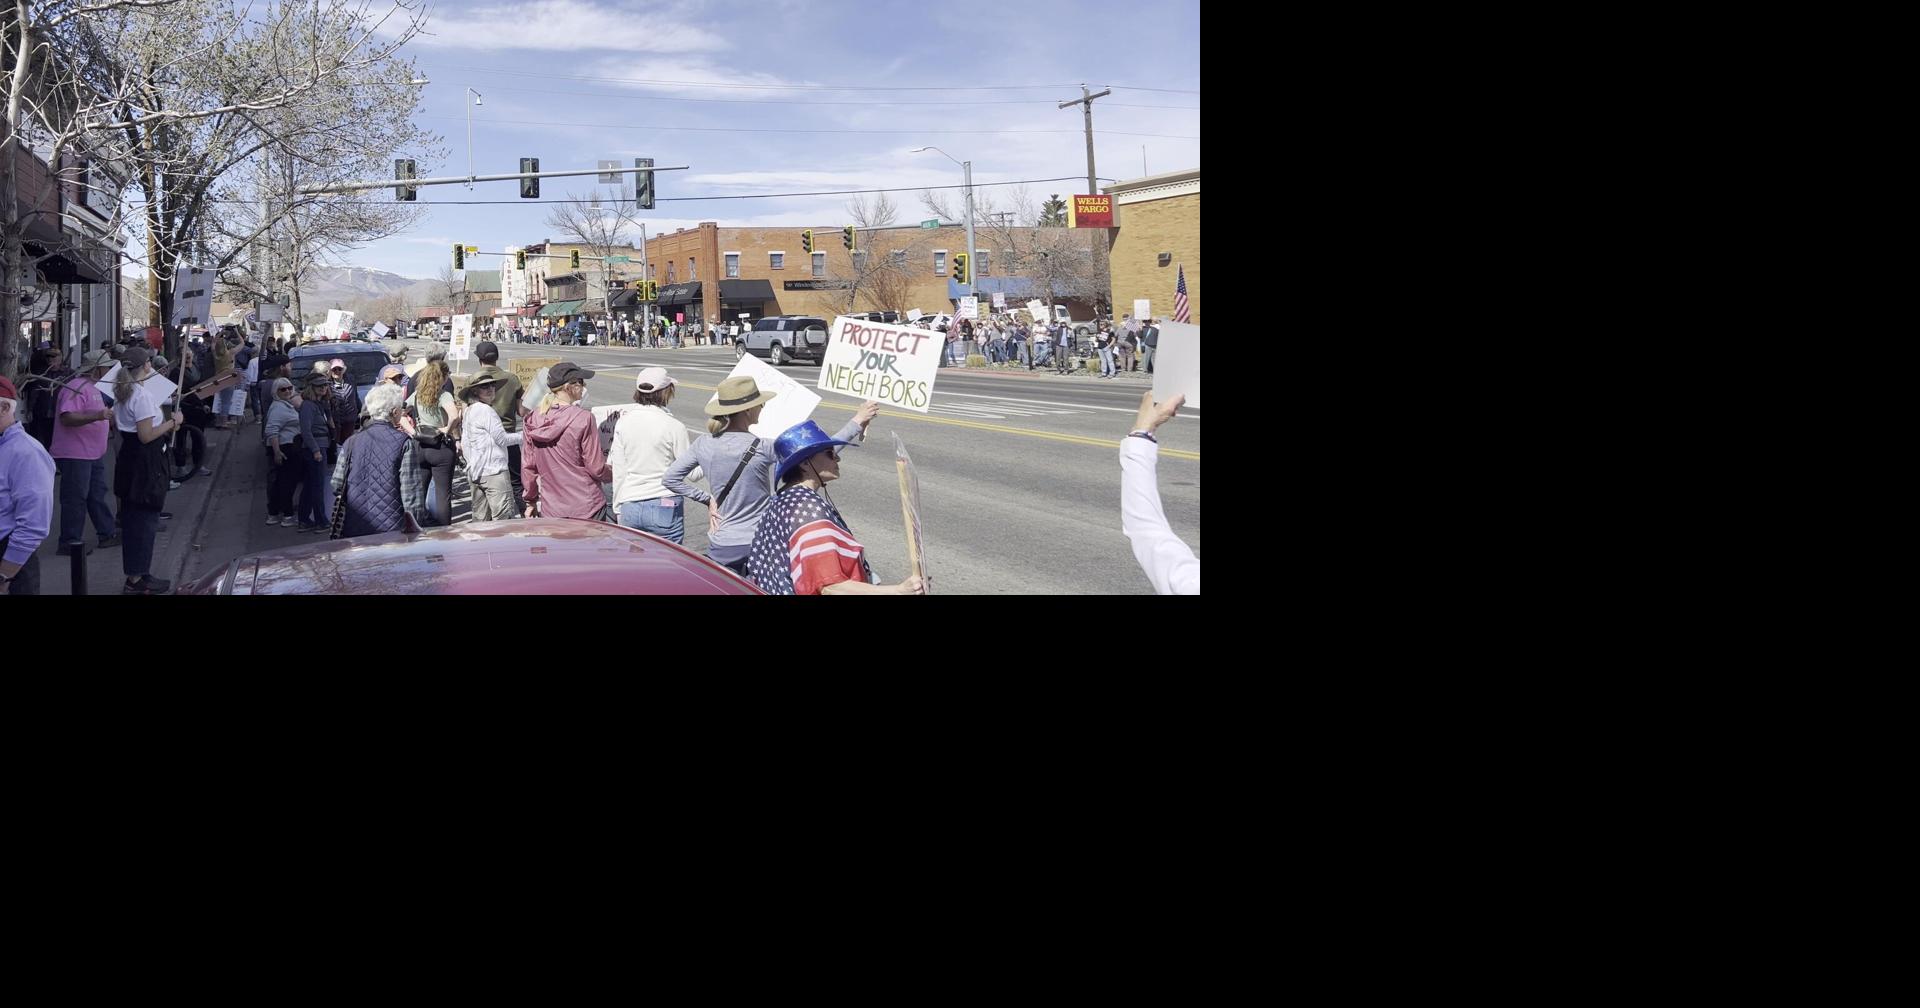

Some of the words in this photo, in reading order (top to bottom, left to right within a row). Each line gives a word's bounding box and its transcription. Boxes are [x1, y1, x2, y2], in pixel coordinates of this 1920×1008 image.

[1076, 197, 1109, 205] WELLS
[1078, 205, 1109, 213] FARGO
[840, 322, 930, 355] PROTECT
[854, 349, 902, 377] YOUR
